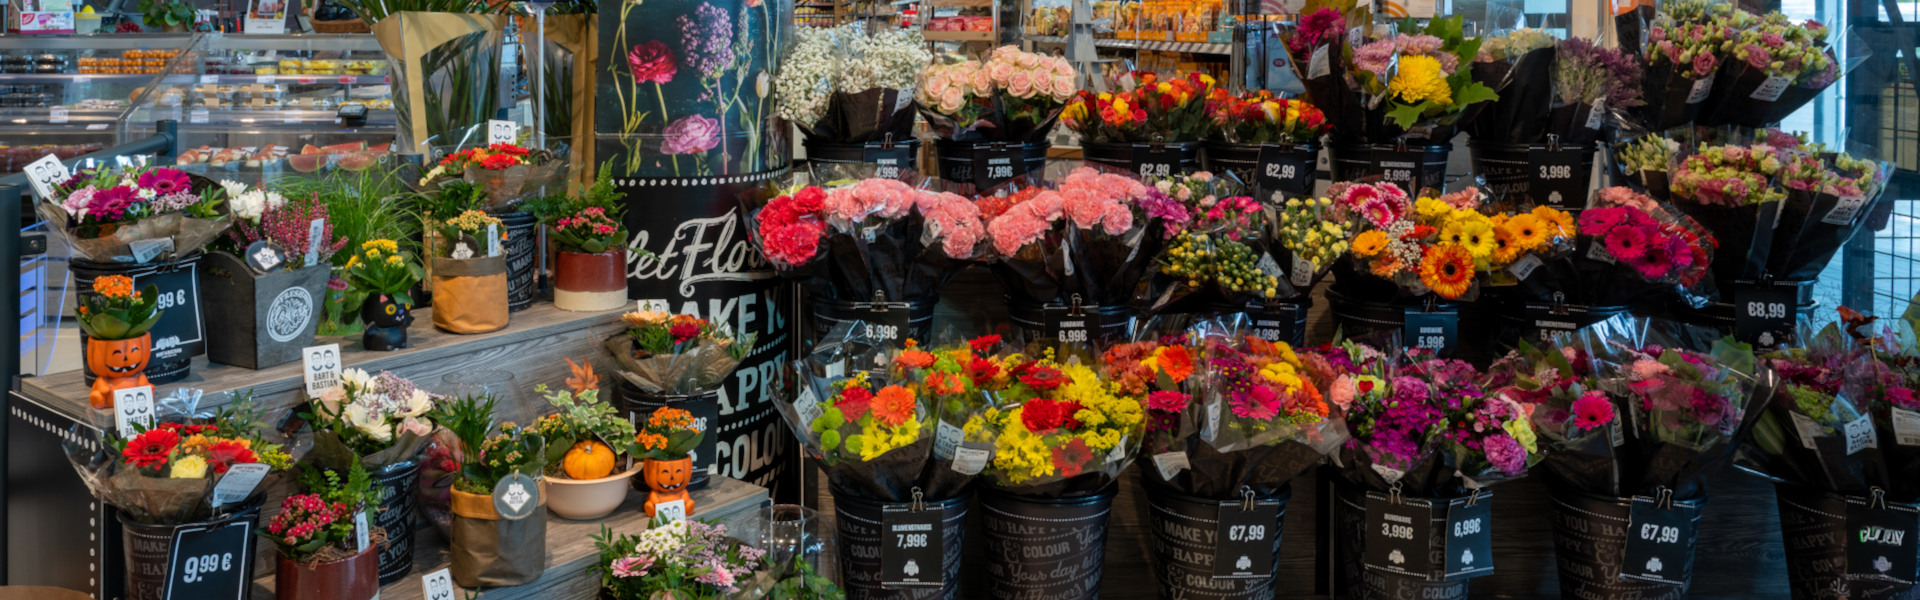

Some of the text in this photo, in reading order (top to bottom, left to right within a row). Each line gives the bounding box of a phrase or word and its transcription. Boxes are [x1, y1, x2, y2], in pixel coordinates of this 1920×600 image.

[987, 166, 1013, 179] 7,99€
[1265, 162, 1296, 180] €2,99
[1383, 169, 1412, 182] 5,99€
[1539, 164, 1571, 180] 3,99€
[1747, 301, 1786, 320] €8,99
[866, 323, 898, 340] 6,99€
[1058, 329, 1088, 343] 6,99€
[1418, 335, 1445, 349] 5,99€
[312, 379, 338, 390] BASTIAN
[313, 371, 330, 381] BART
[1164, 520, 1201, 543] MAKE
[1229, 525, 1265, 543] €7,99
[1381, 522, 1414, 540] 3,99€
[1454, 517, 1481, 538] 6,99€
[1641, 523, 1680, 543] €7,99
[134, 539, 168, 553] MAKE
[896, 533, 928, 549] 7,99€
[1023, 541, 1070, 559] COLOUR
[221, 552, 233, 572] €
[1008, 562, 1048, 584] Your
[1050, 560, 1080, 581] day
[1422, 582, 1464, 600] COLOUR
